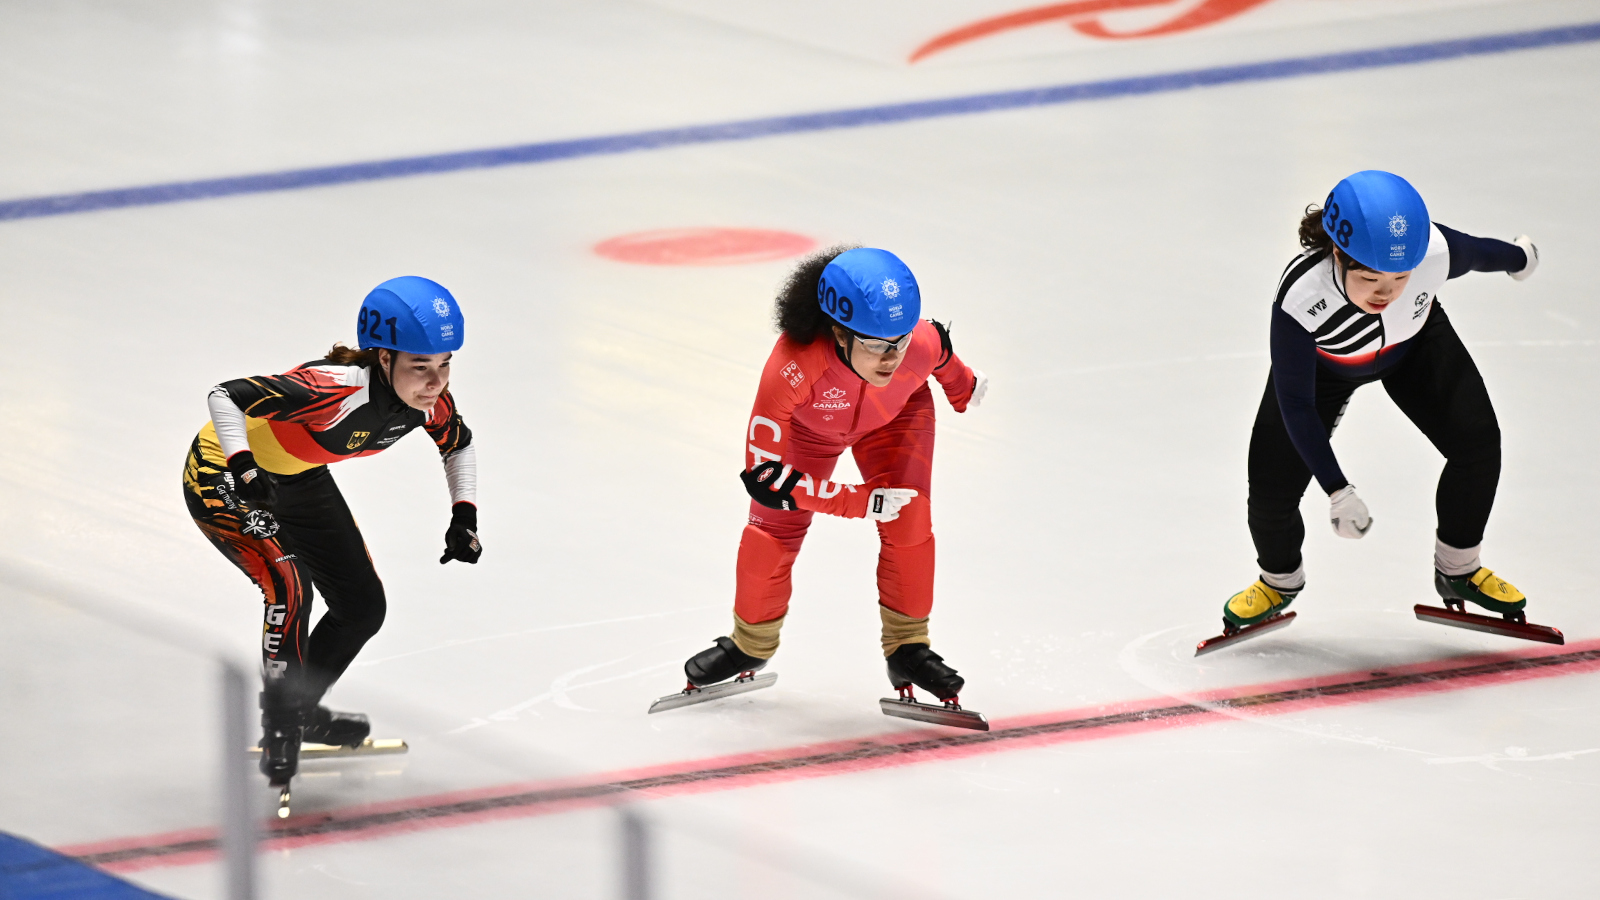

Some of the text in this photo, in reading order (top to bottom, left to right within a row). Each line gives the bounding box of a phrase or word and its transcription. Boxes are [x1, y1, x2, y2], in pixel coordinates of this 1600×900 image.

[1322, 191, 1354, 248] 938
[819, 277, 853, 322] 909
[360, 306, 398, 346] 921
[782, 363, 797, 378] APO
[790, 372, 804, 386] GEE
[748, 415, 858, 499] CAAD
[216, 484, 238, 510] Gemany
[264, 604, 288, 679] GER
